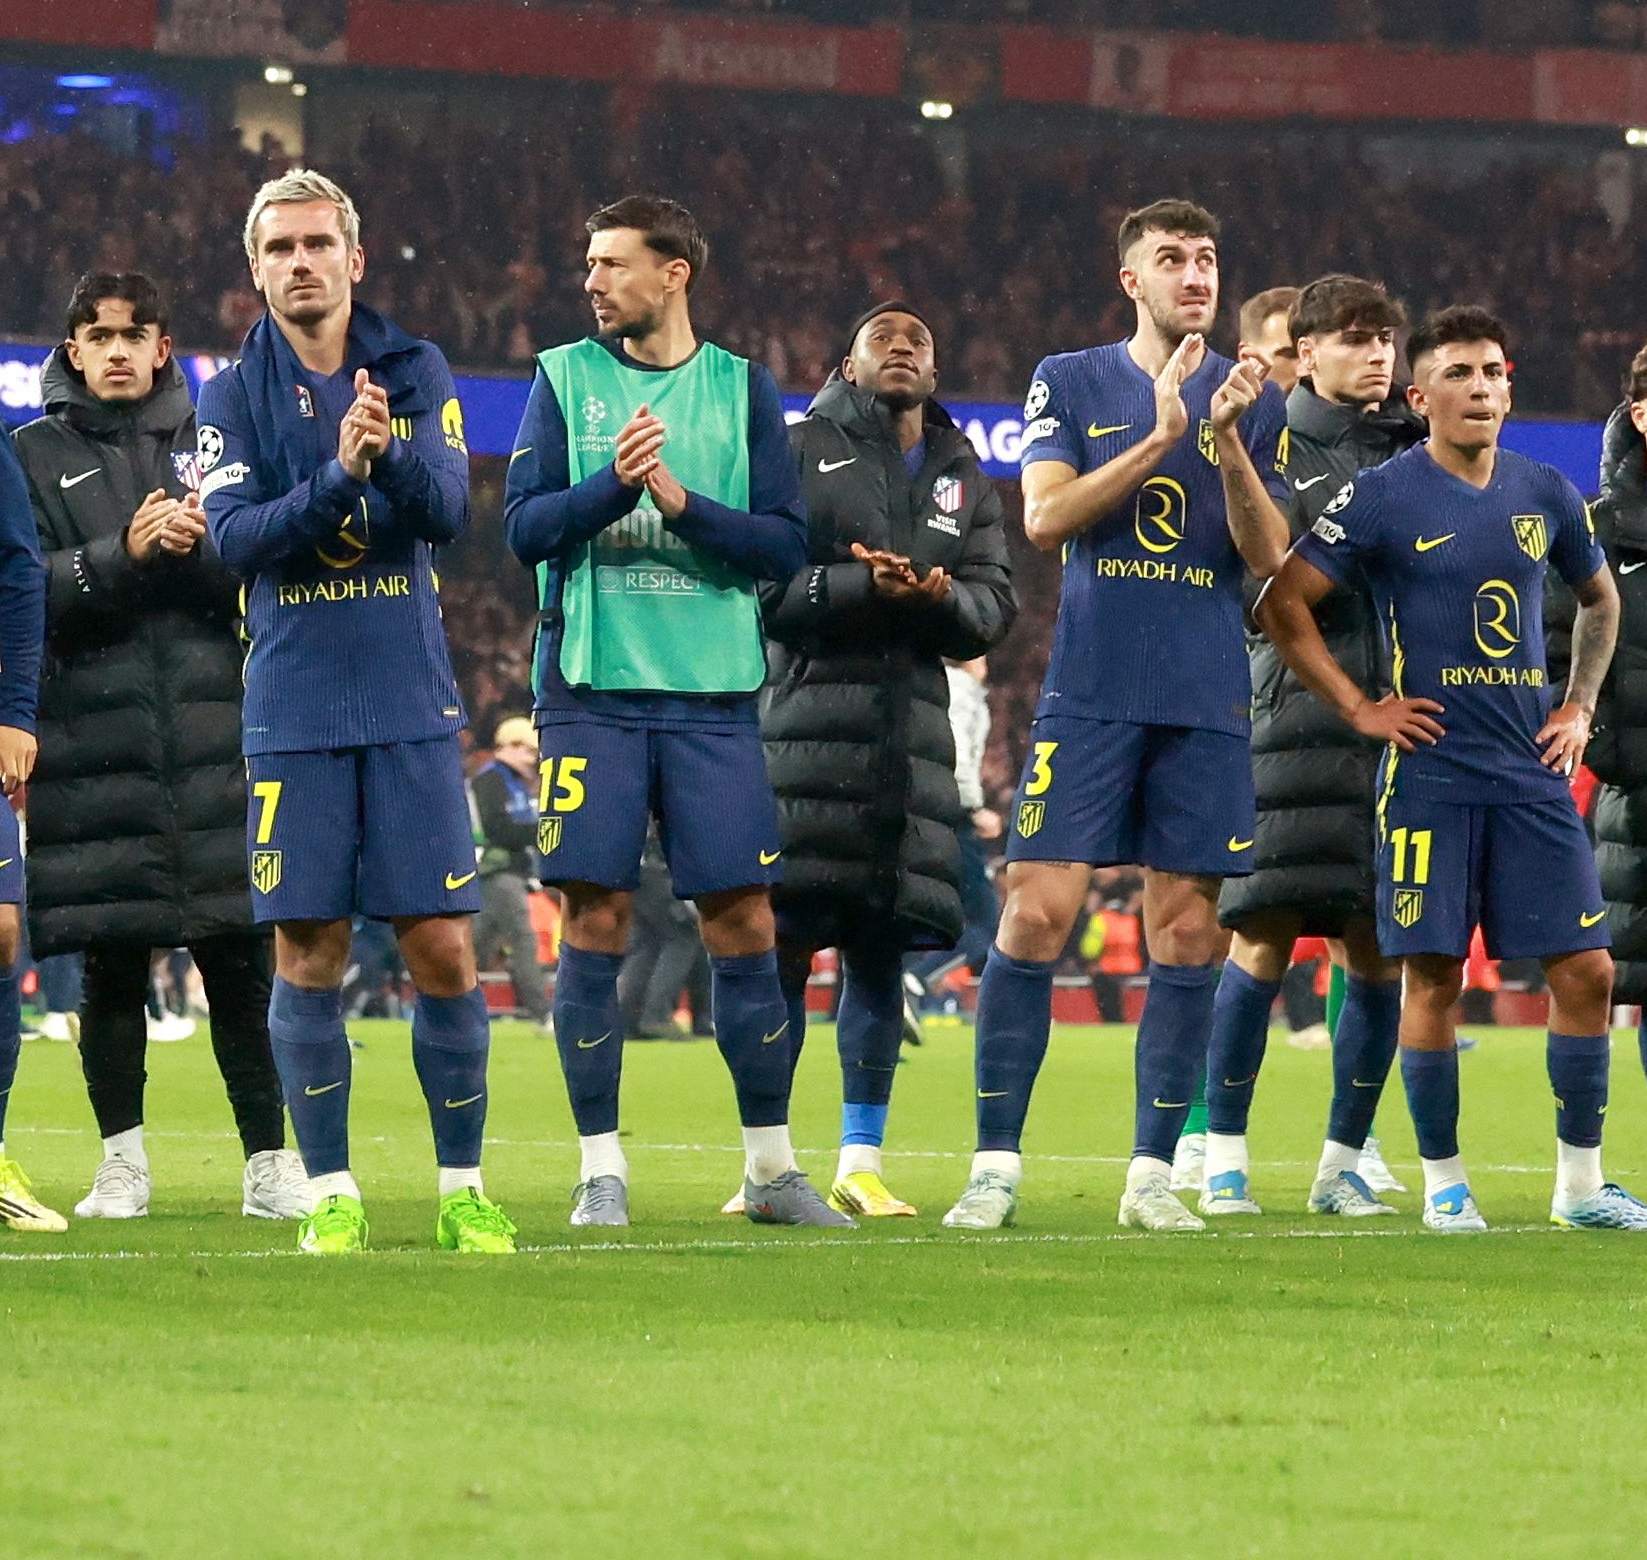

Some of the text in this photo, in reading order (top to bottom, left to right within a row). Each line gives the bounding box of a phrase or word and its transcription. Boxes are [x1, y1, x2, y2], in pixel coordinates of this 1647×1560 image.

[656, 24, 838, 87] Arsenal
[935, 513, 958, 527] VISIT
[279, 575, 410, 606] RIYADH AIR
[1097, 558, 1214, 588] RIYADH AIR
[1442, 666, 1544, 688] RIYADH AIR
[538, 756, 588, 813] 15
[1025, 741, 1059, 796] 3
[253, 781, 283, 845] 7
[1391, 827, 1432, 885] 11
